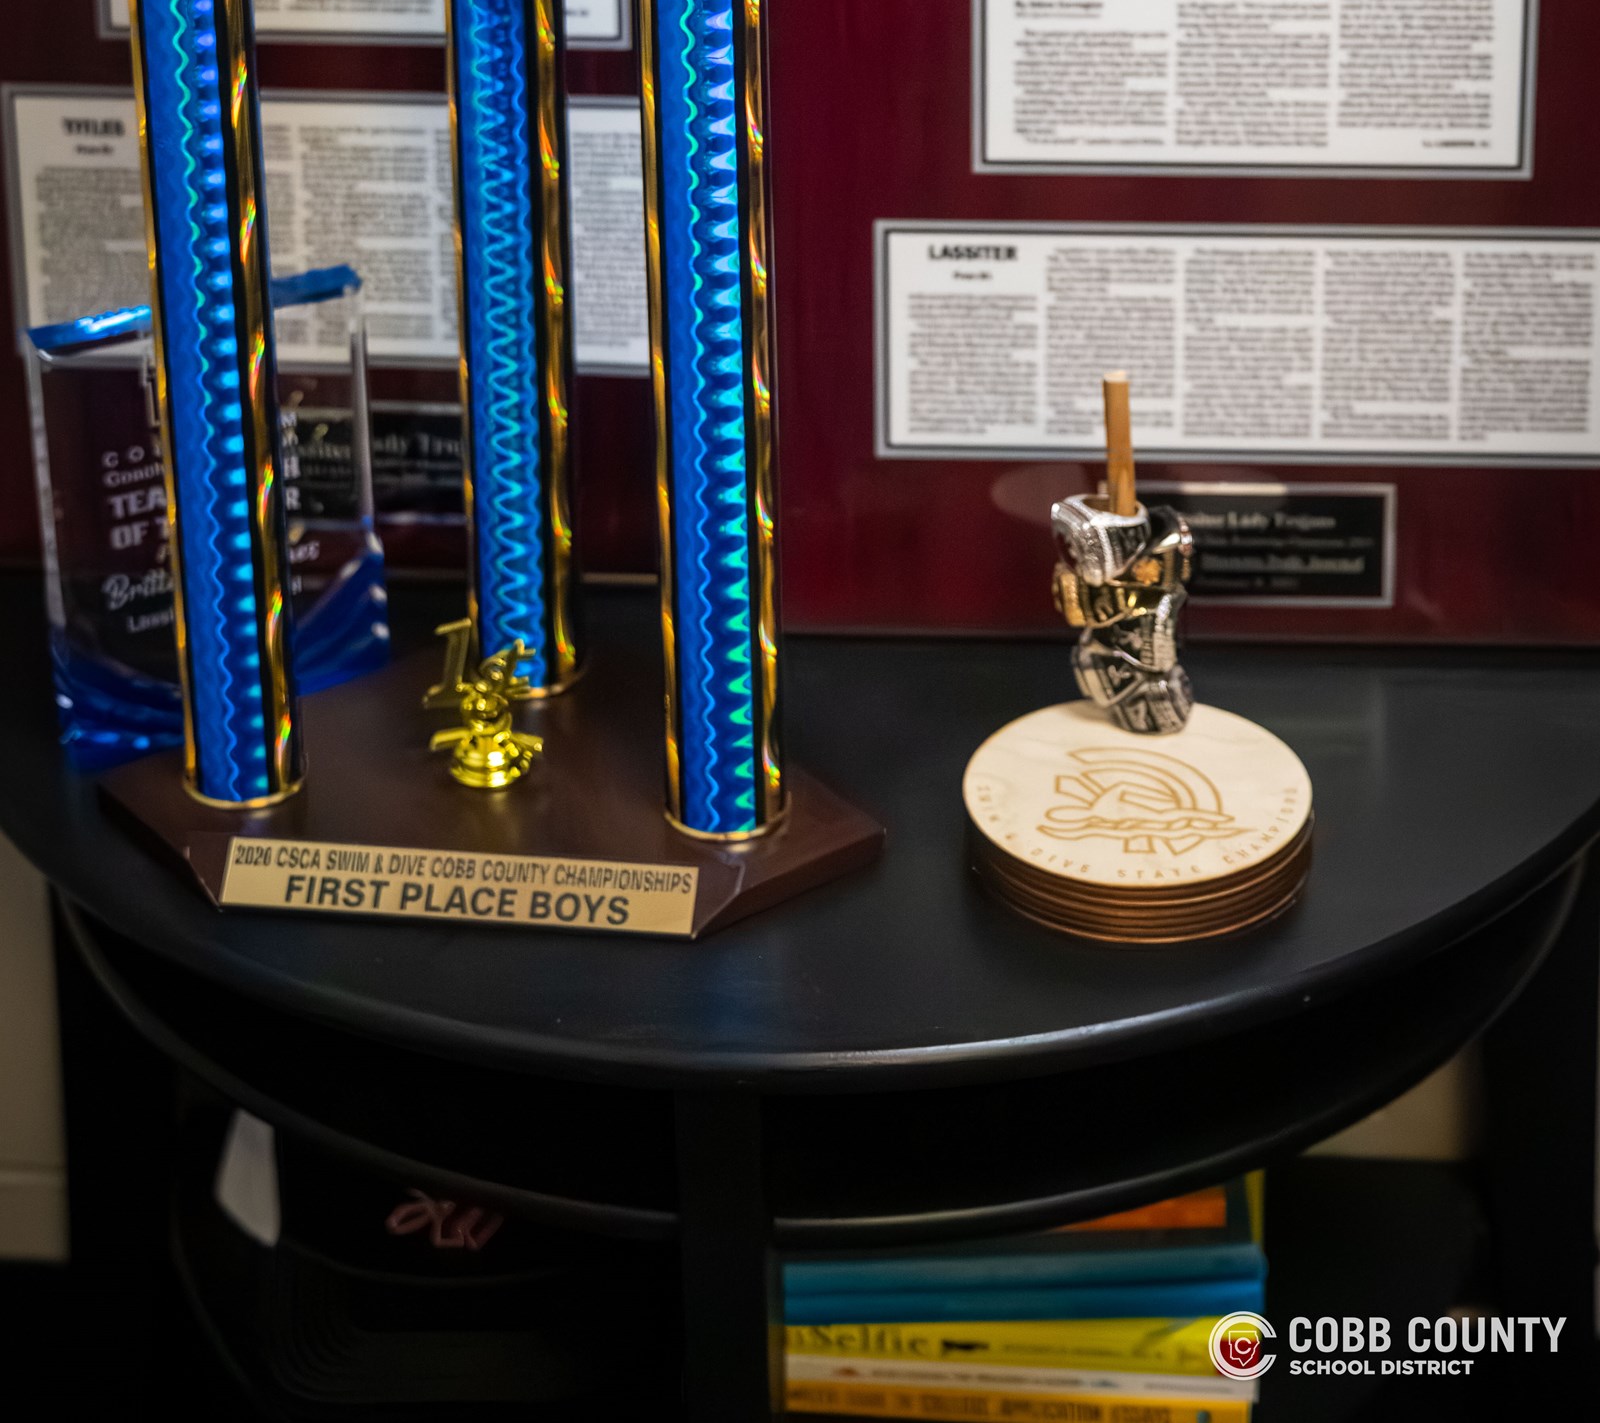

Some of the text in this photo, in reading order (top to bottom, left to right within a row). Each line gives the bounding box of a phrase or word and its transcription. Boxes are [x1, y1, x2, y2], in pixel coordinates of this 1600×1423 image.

[928, 244, 1018, 262] LASSITER
[276, 846, 321, 871] CSCA
[326, 849, 370, 874] SWIM
[374, 853, 384, 875] &
[388, 854, 427, 877] DIVE
[431, 856, 477, 879] COBB
[482, 859, 550, 884] COUNTY
[554, 864, 693, 895] CHAMPIONSHIPS
[1116, 865, 1202, 880] STATE
[284, 875, 630, 925] FIRST PLACE BOYS
